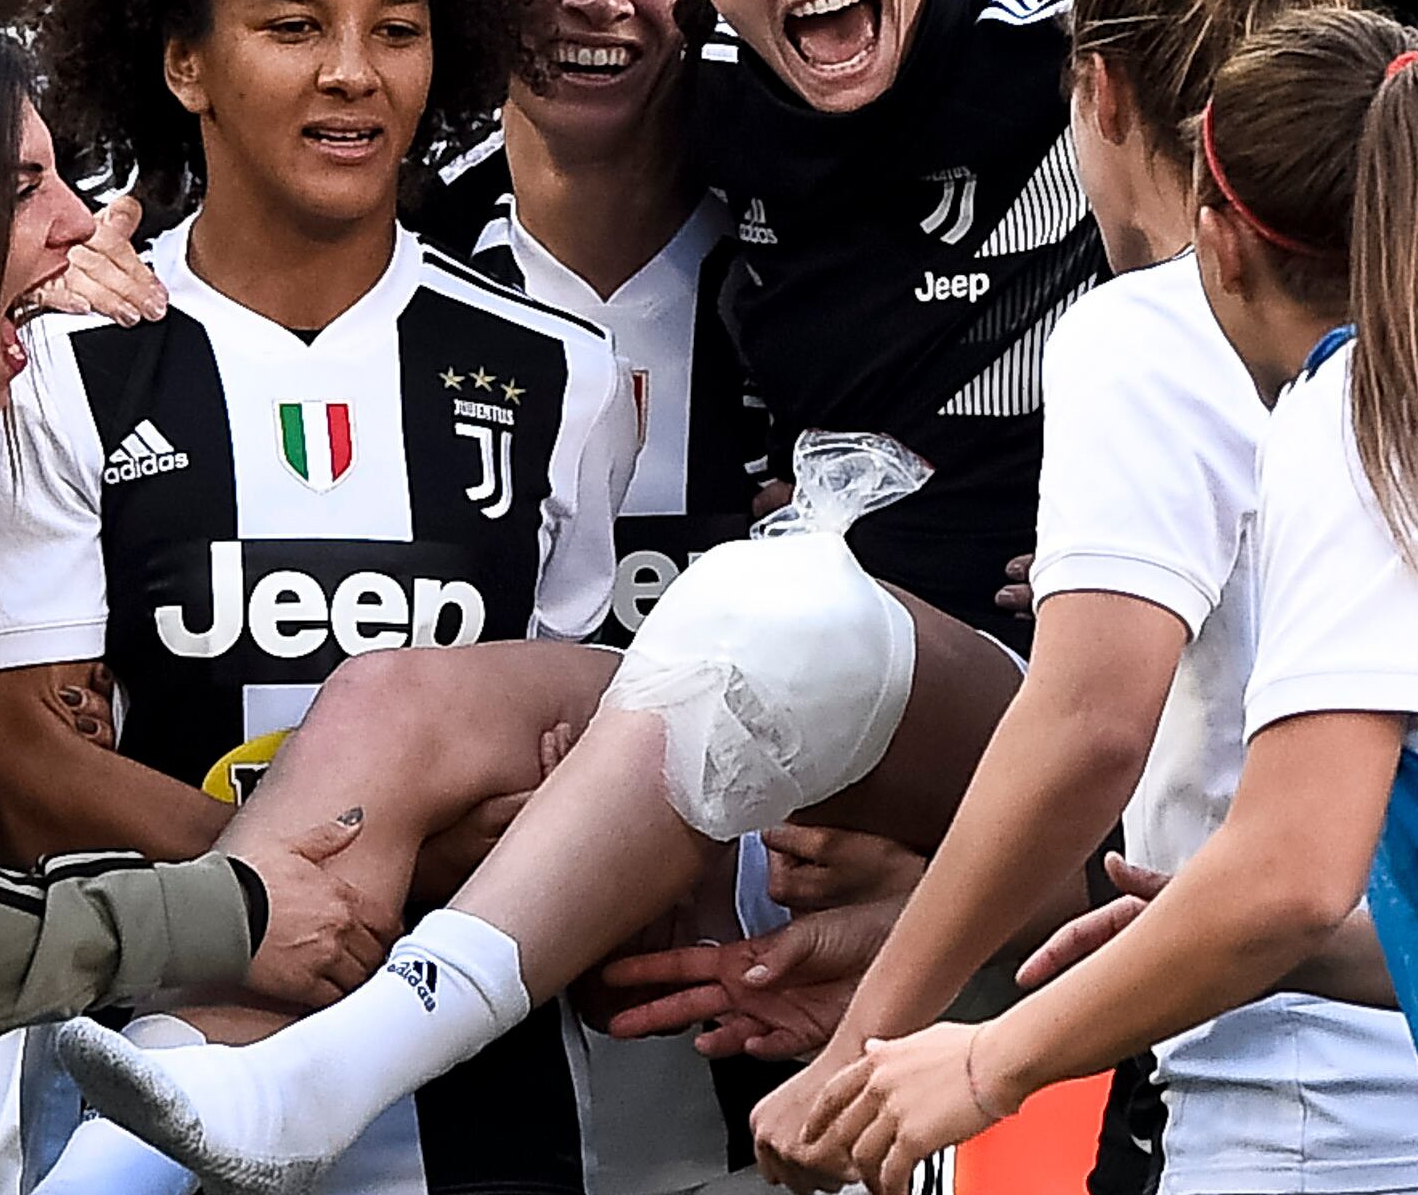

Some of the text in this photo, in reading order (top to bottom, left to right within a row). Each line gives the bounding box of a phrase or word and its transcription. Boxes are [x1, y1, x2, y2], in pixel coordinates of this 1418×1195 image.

[914, 271, 990, 303] Jeep
[453, 398, 515, 426] JUVENTUS
[104, 452, 189, 484] adidas
[154, 541, 485, 658] Jeep
